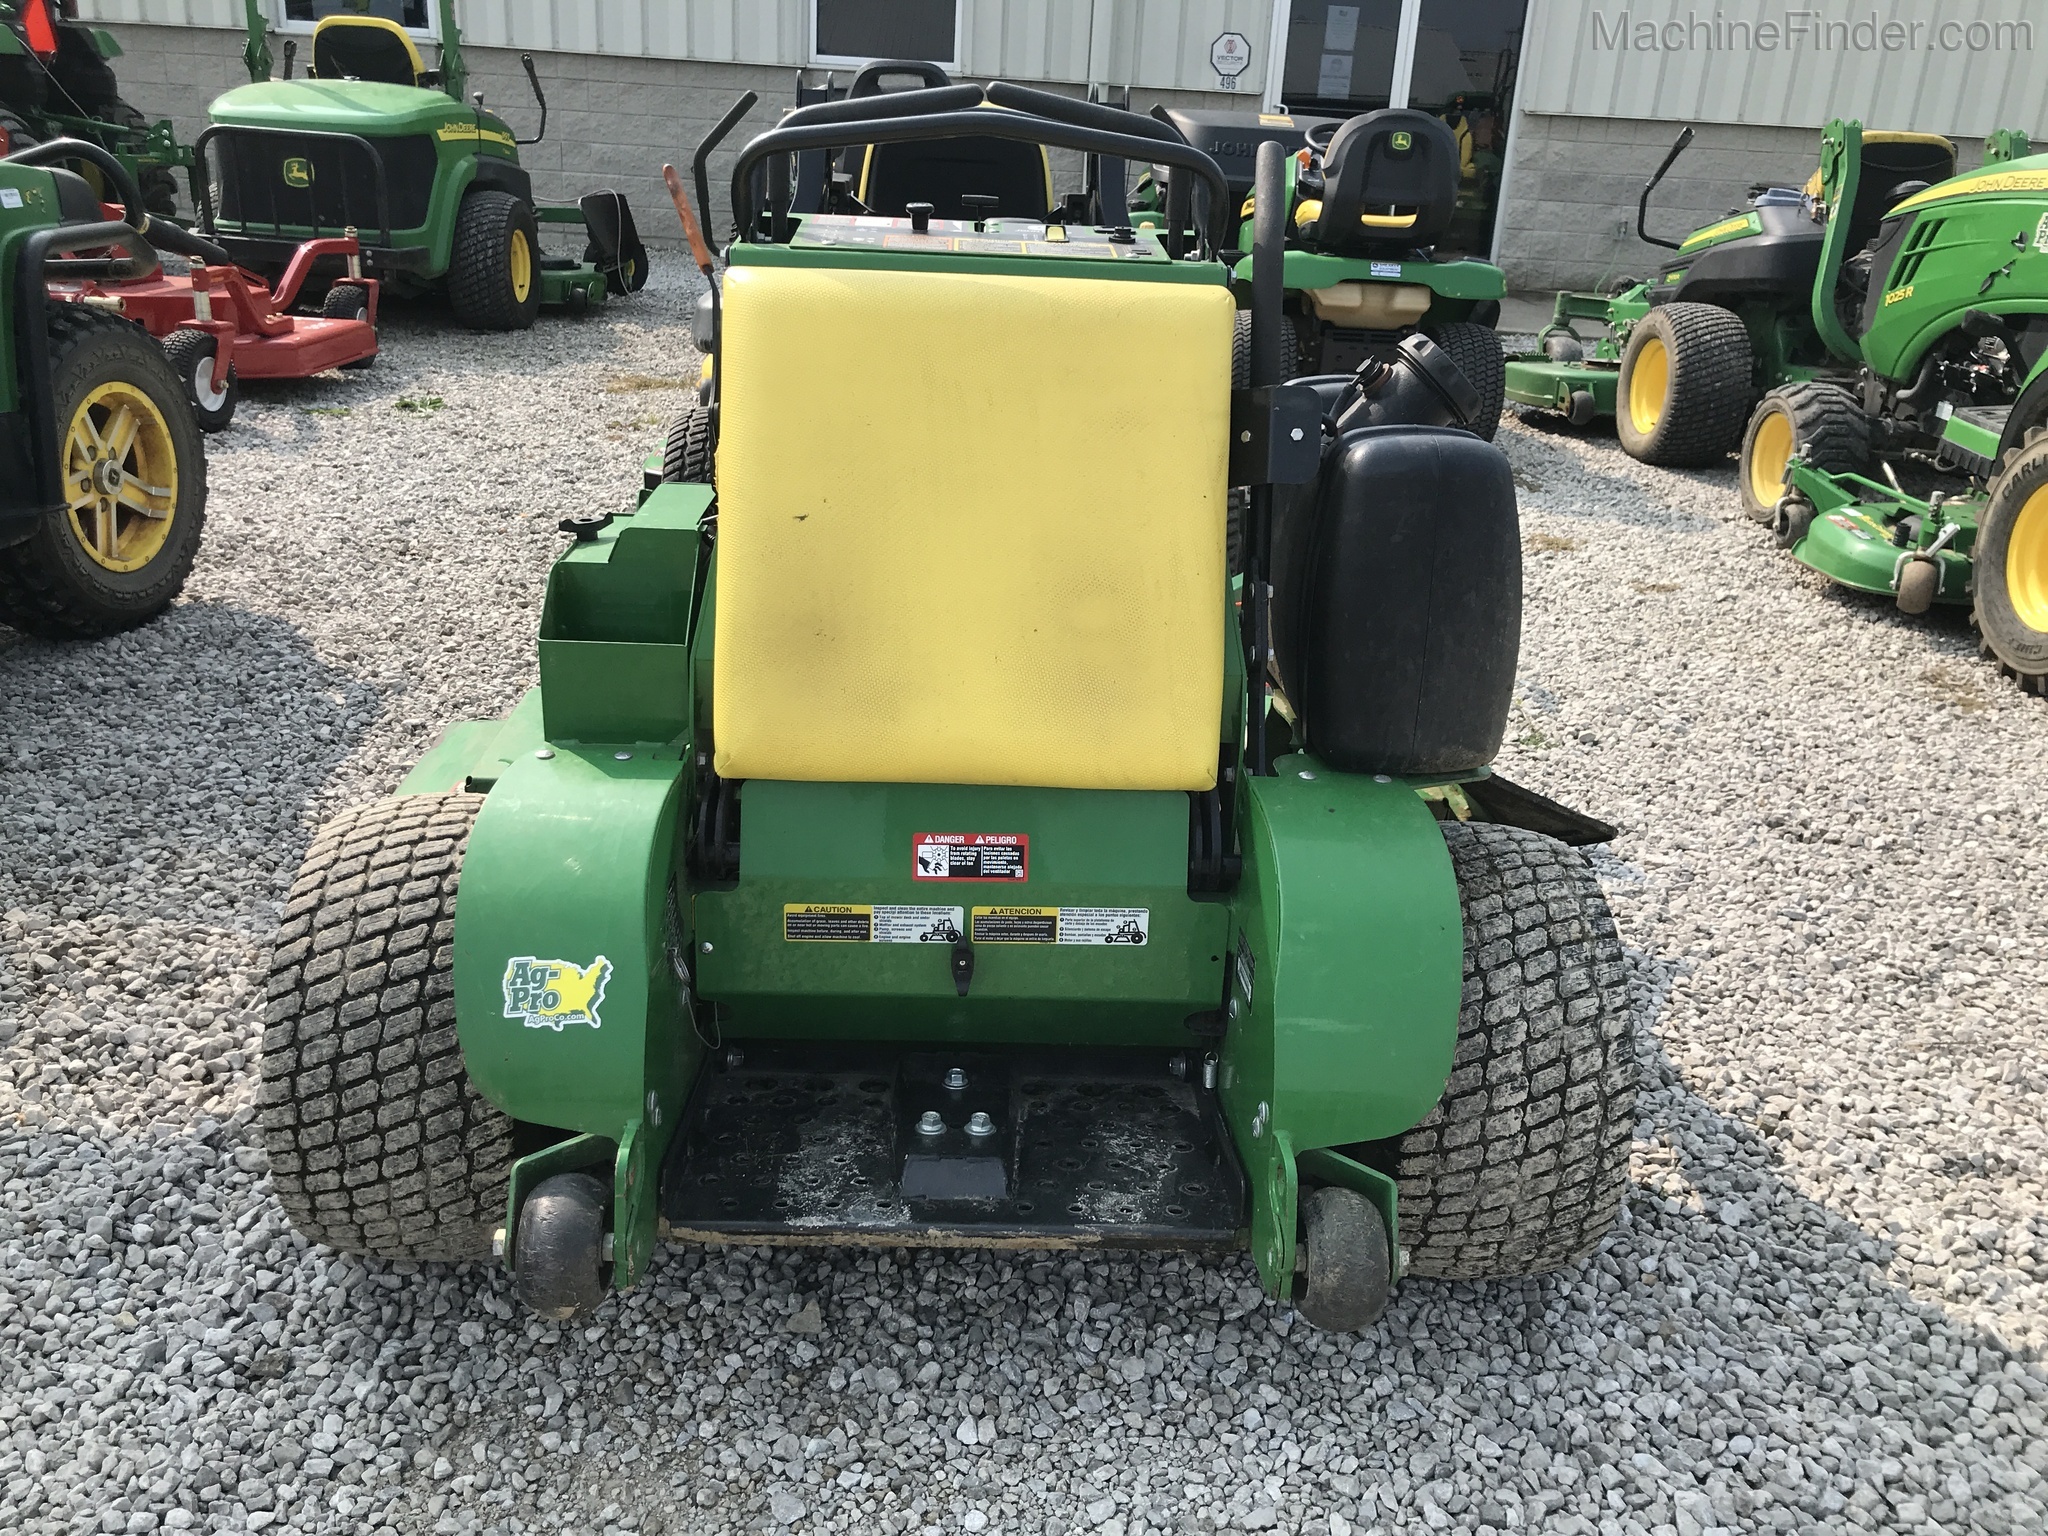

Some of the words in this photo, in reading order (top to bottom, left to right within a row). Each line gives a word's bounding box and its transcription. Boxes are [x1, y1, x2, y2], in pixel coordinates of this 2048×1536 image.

[1220, 76, 1236, 90] 496
[1969, 178, 2002, 191] JOHN
[2003, 176, 2047, 189] DEERE
[986, 836, 1017, 844] PELIGRO
[509, 961, 559, 991] Ag-
[509, 986, 559, 1012] Pro
[528, 1013, 586, 1024] AgProCo.com
